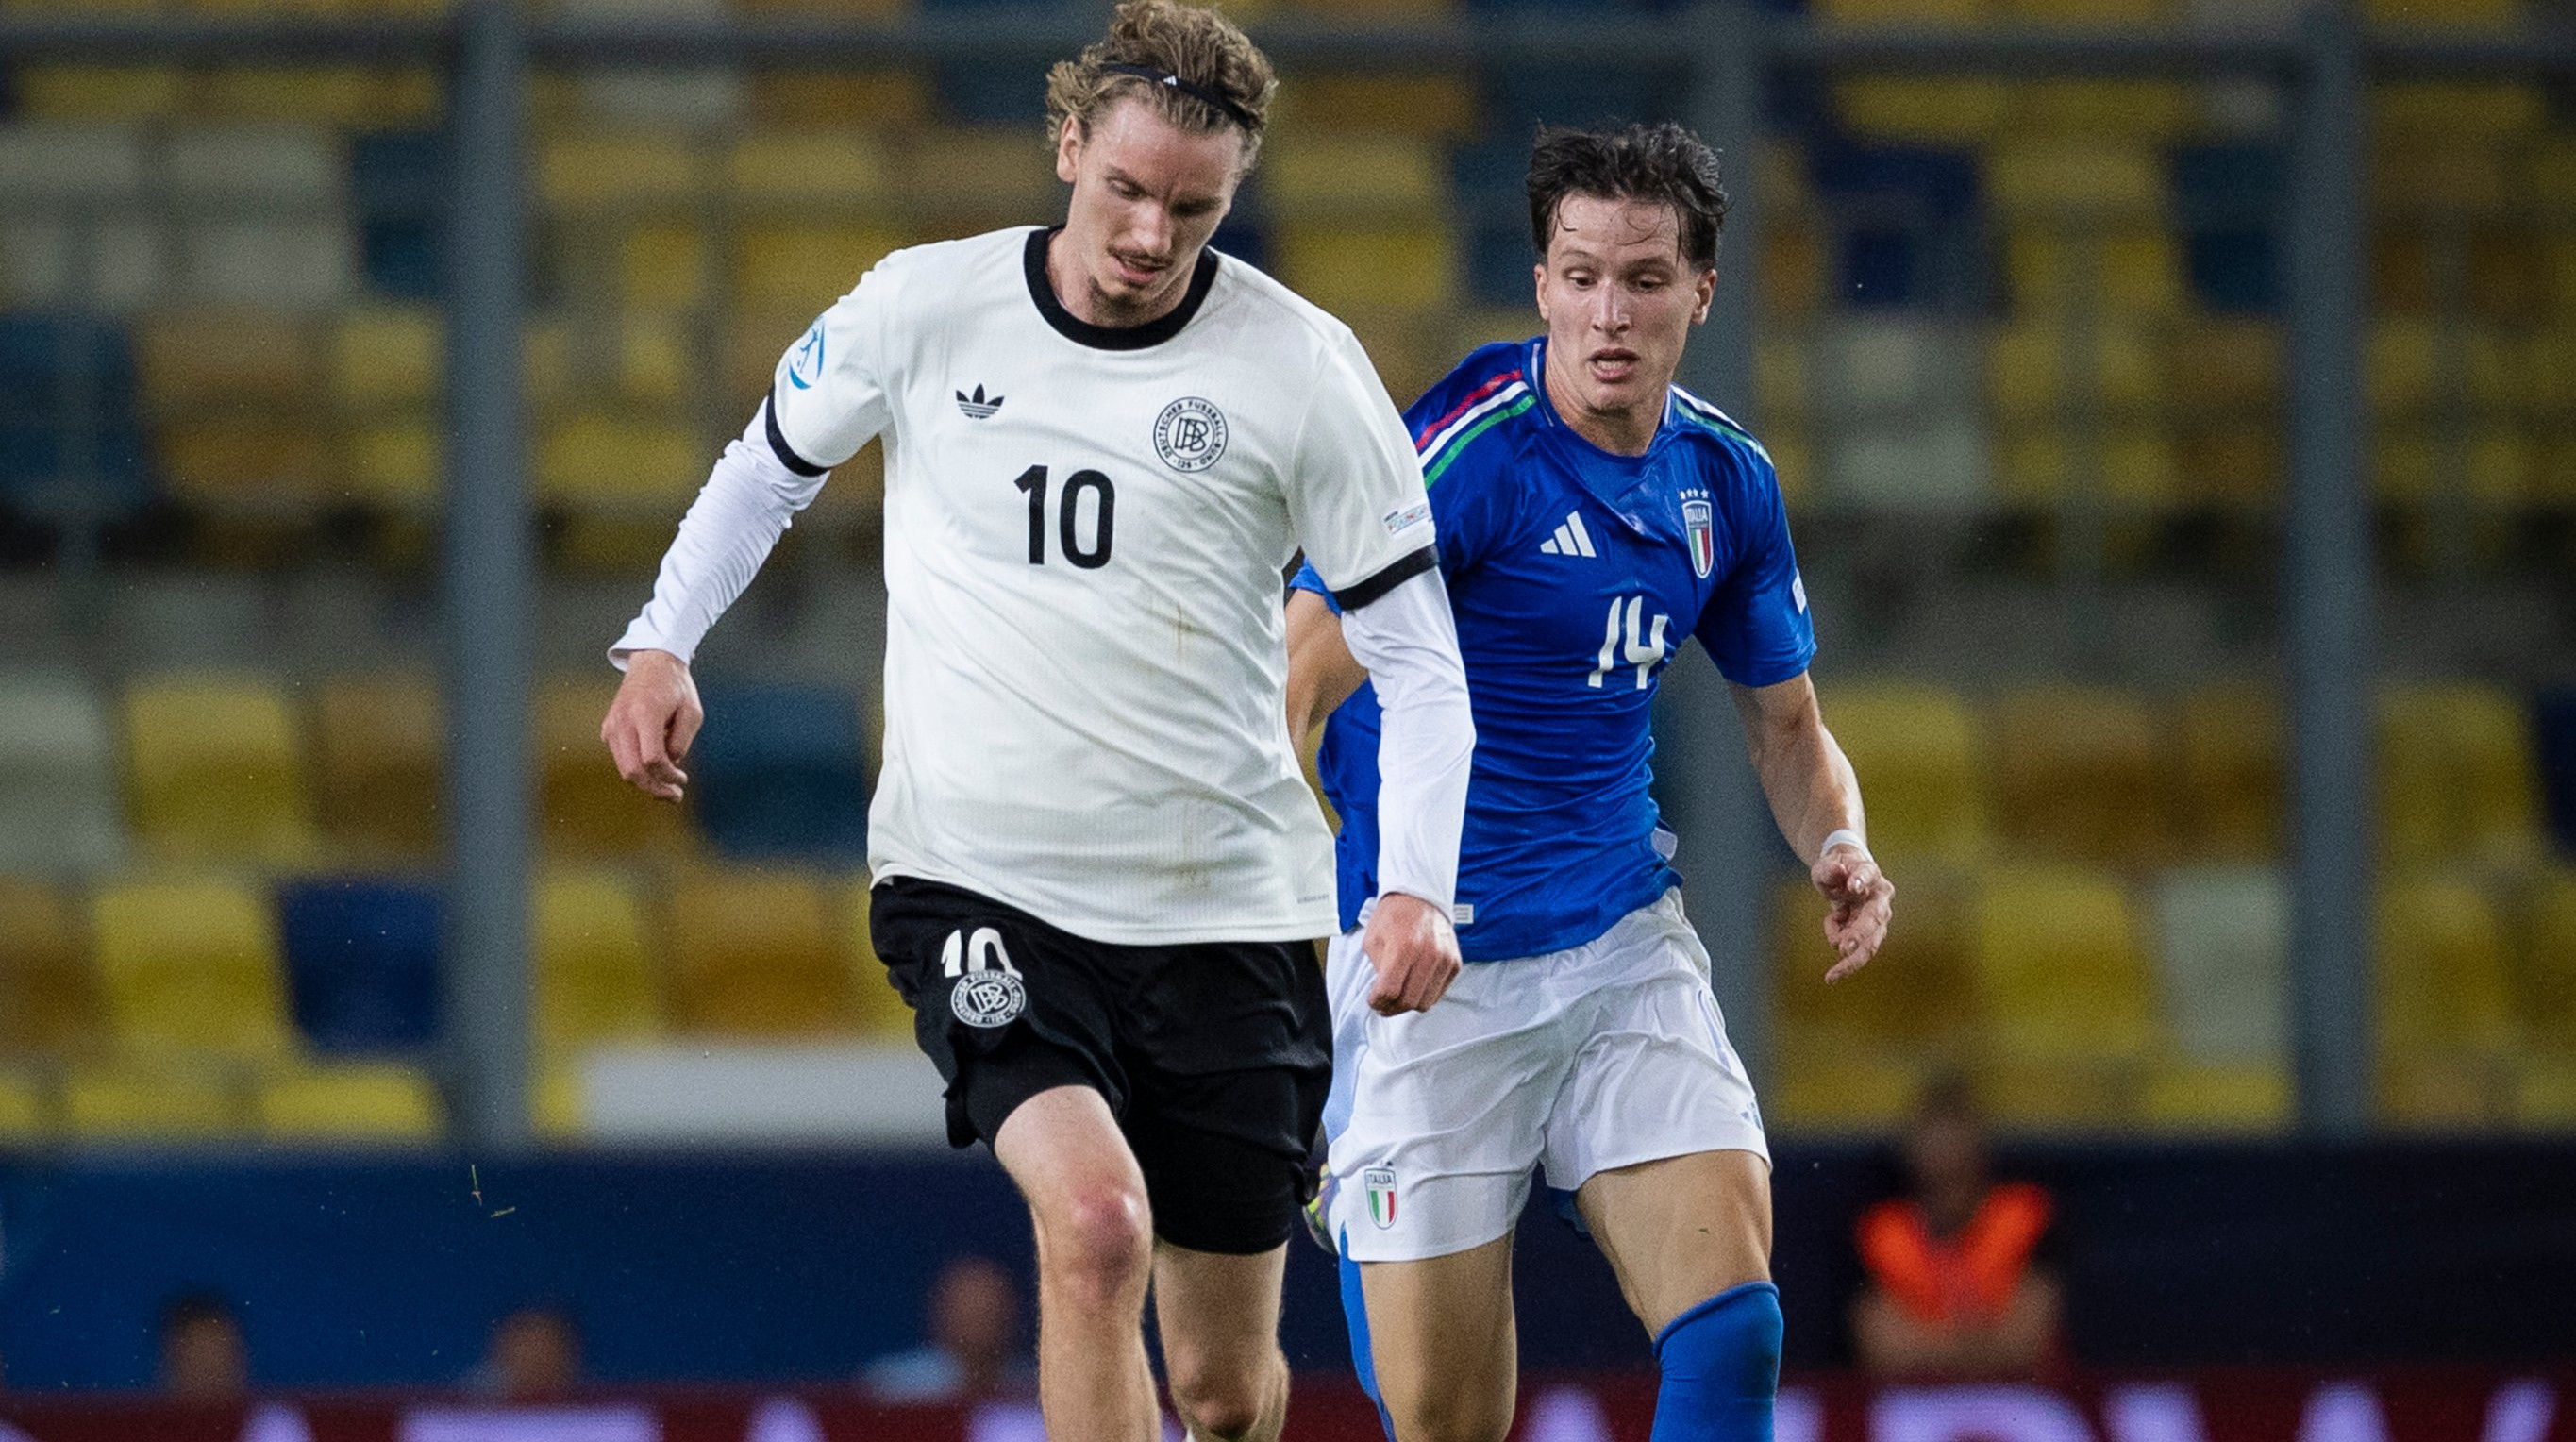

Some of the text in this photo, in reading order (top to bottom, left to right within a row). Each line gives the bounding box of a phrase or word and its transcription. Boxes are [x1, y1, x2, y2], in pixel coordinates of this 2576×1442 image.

[1013, 464, 1115, 570] 10
[1588, 595, 1669, 690] 14
[941, 927, 1023, 981] 10
